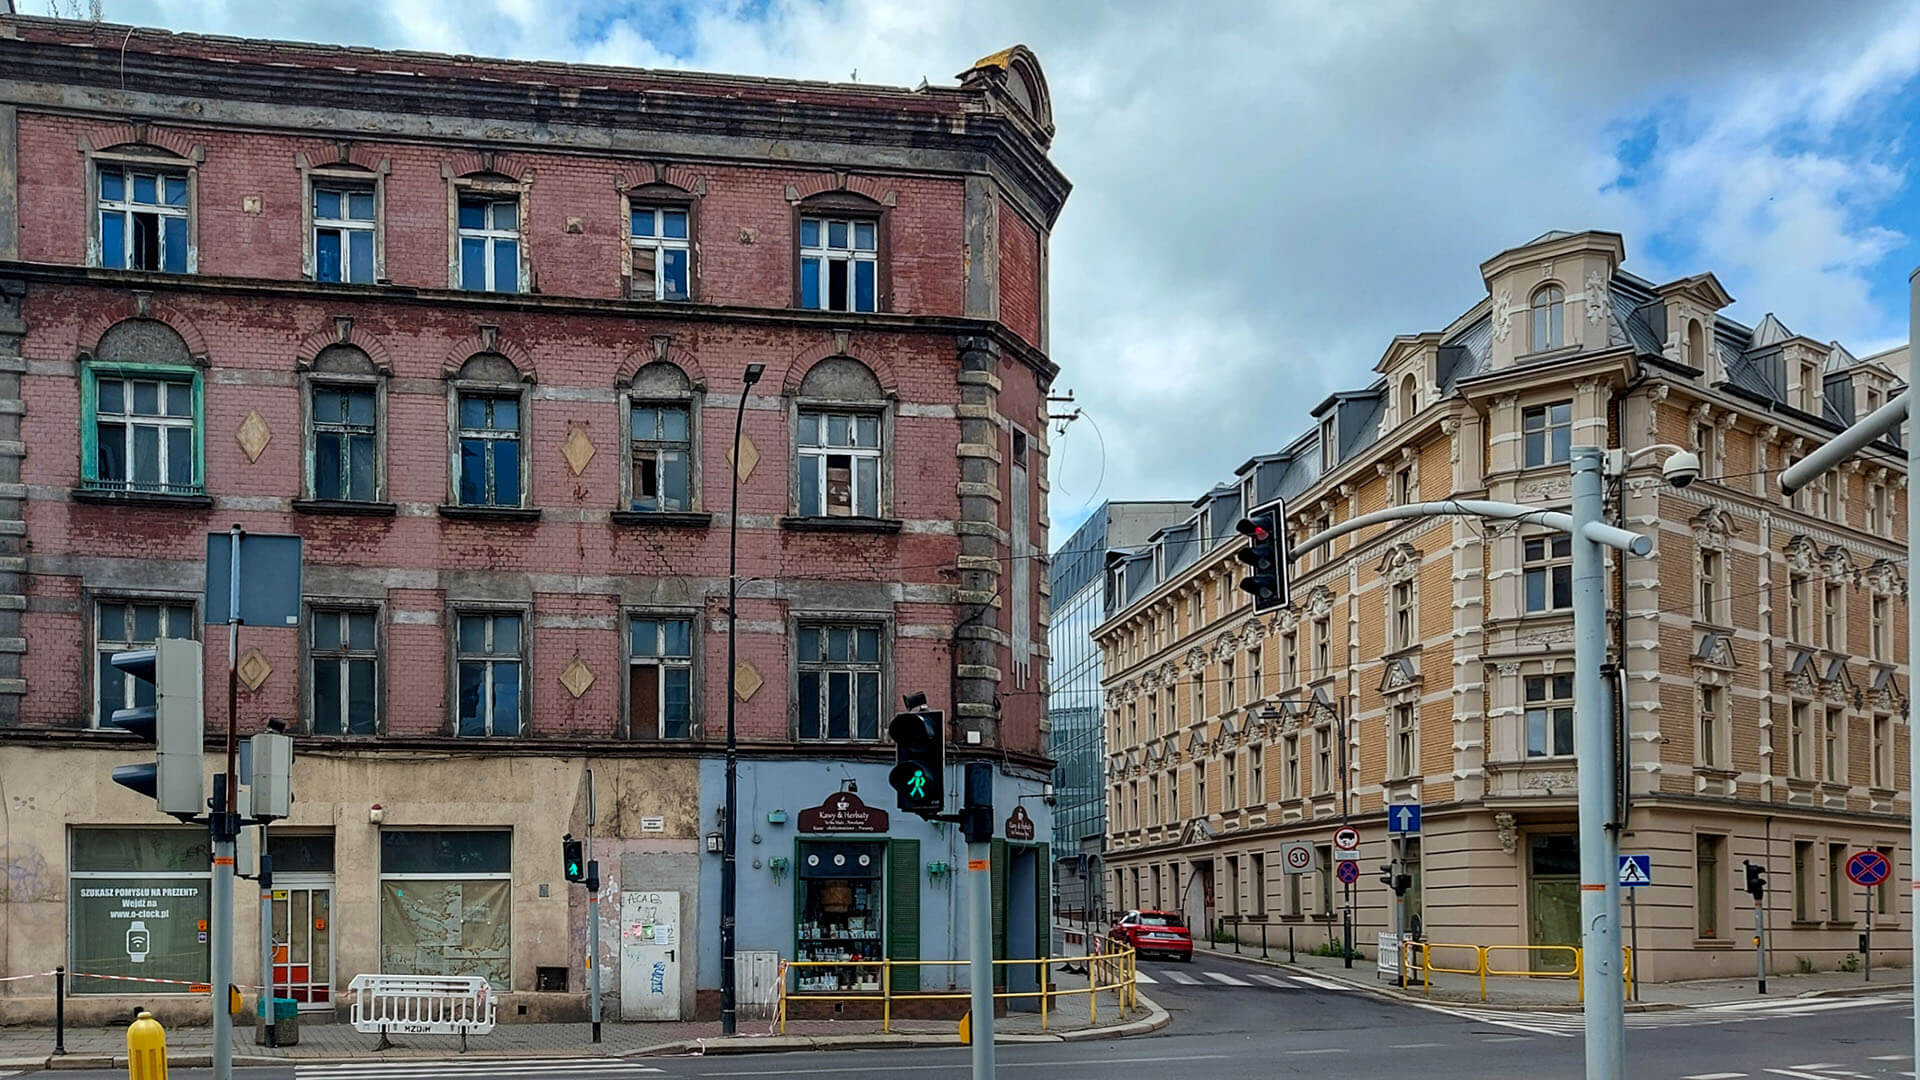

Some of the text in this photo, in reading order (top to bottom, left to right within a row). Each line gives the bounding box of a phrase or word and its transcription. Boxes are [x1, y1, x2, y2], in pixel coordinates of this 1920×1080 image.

[1292, 853, 1306, 862] 30
[80, 887, 198, 897] SZUKASZ POMYSŁU NA PREZENT?
[110, 909, 169, 919] www.o-clock.pl
